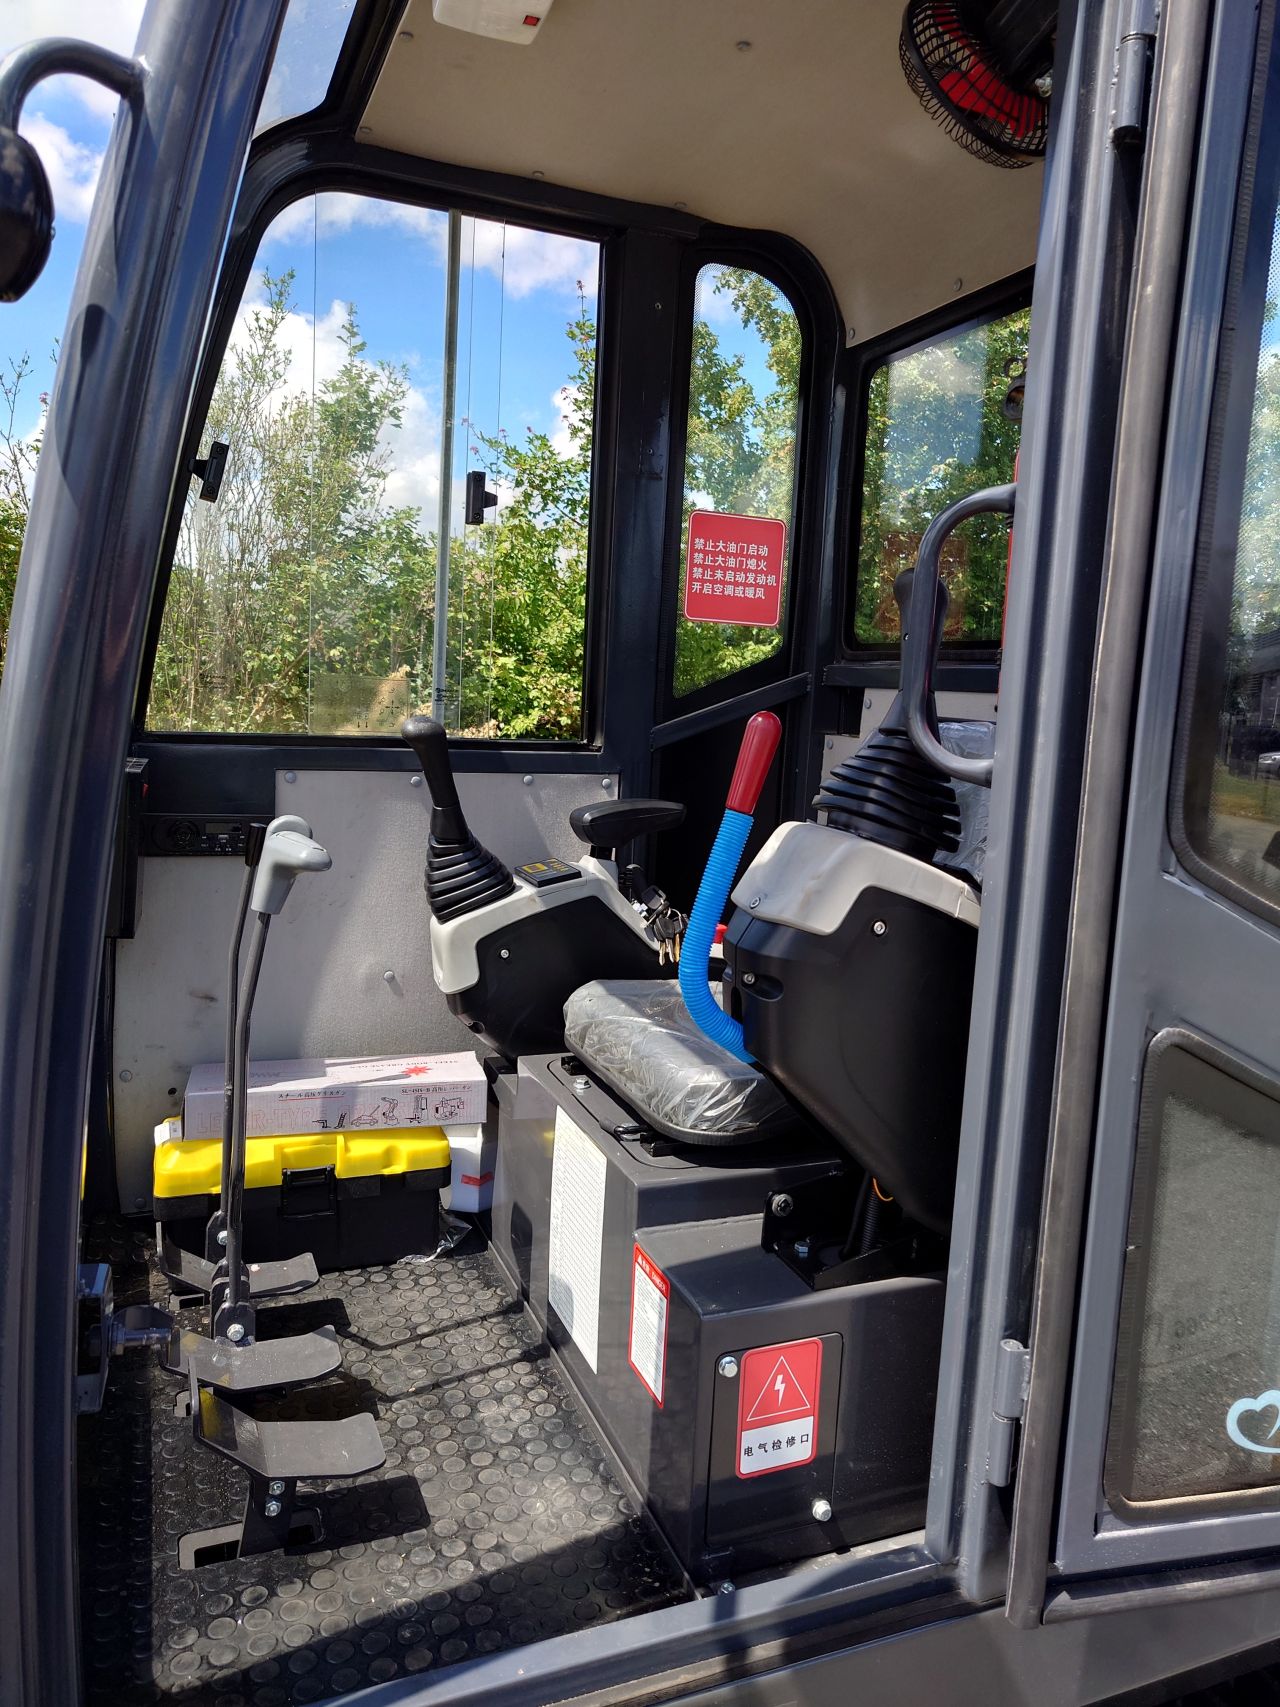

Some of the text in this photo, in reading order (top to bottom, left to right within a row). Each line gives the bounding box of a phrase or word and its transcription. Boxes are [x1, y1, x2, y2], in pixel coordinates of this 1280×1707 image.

[694, 538, 769, 556] 禁止大油门启动
[693, 552, 767, 571] 禁止大油门熄火
[692, 567, 777, 586] 禁止未启动发动机
[691, 582, 765, 599] 开启空调或暖风
[743, 1433, 809, 1457] 电气检修口
